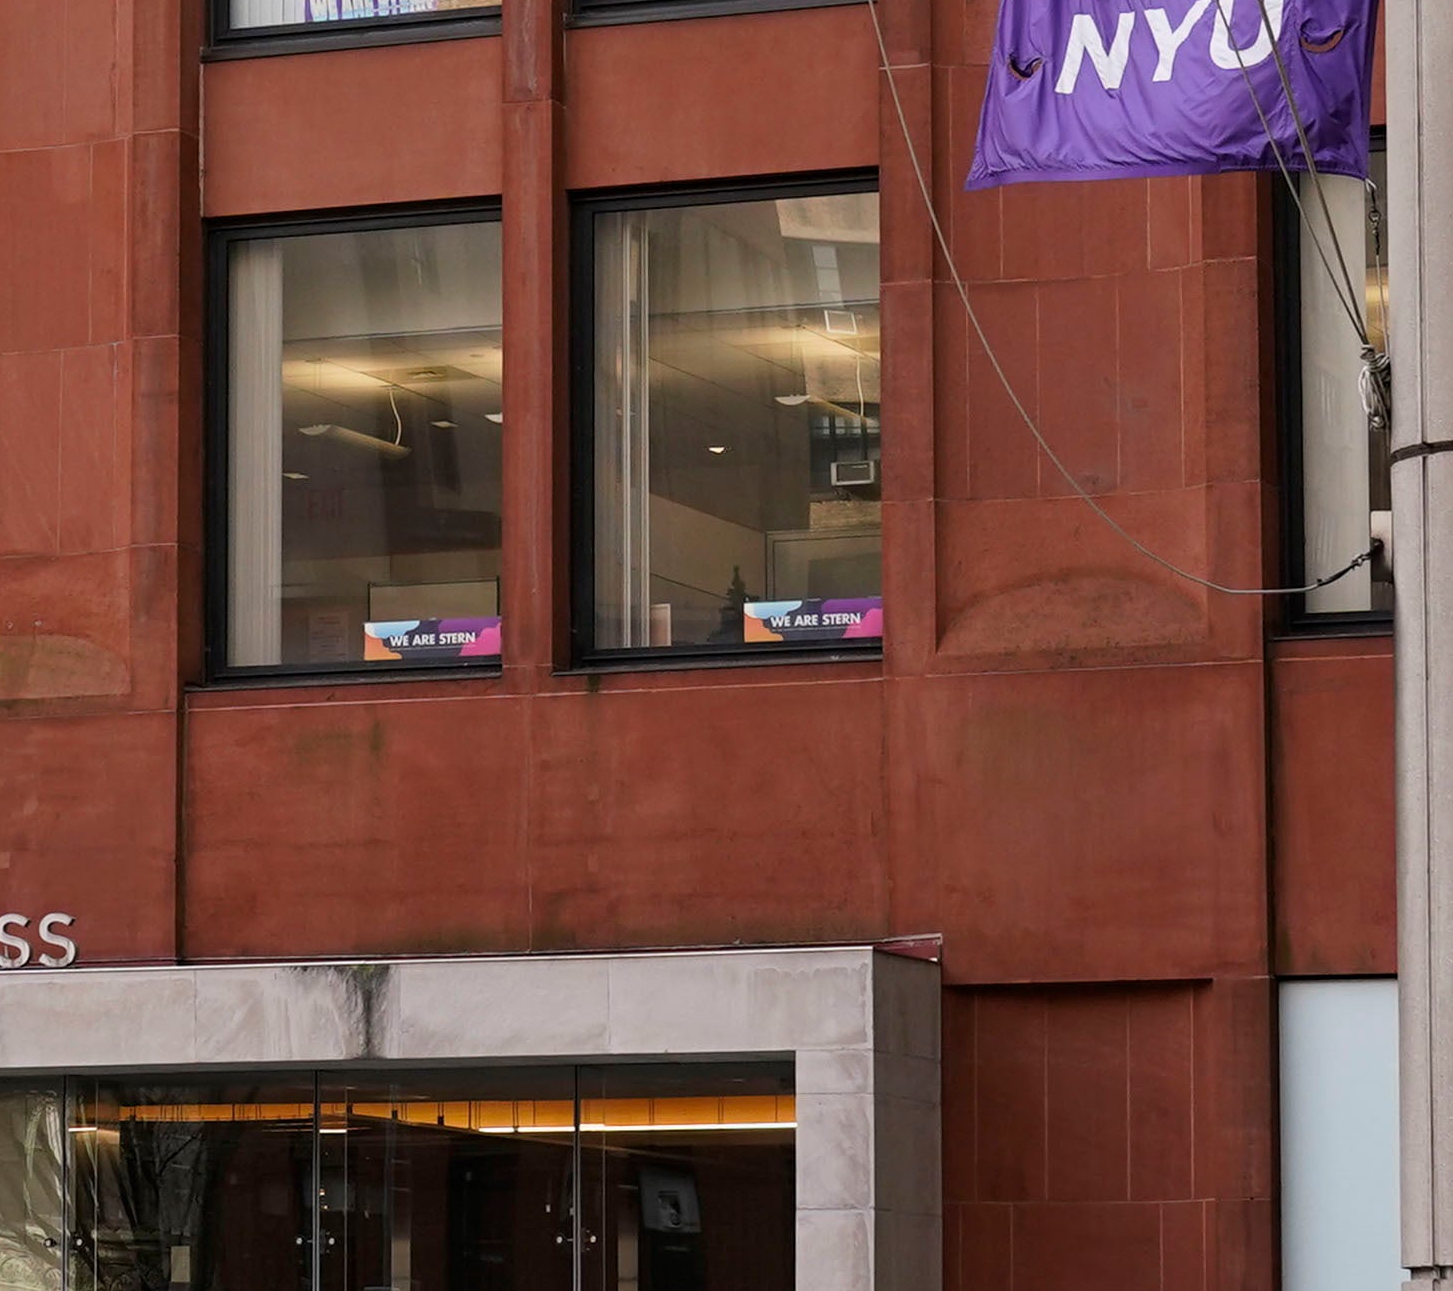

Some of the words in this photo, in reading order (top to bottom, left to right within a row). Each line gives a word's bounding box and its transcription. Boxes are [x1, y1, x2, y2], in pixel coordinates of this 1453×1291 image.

[771, 616, 791, 627] WE
[794, 614, 818, 626] ARE
[822, 612, 861, 625] STERN
[390, 635, 409, 647] WE
[412, 634, 435, 645] ARE
[439, 632, 476, 645] STERN
